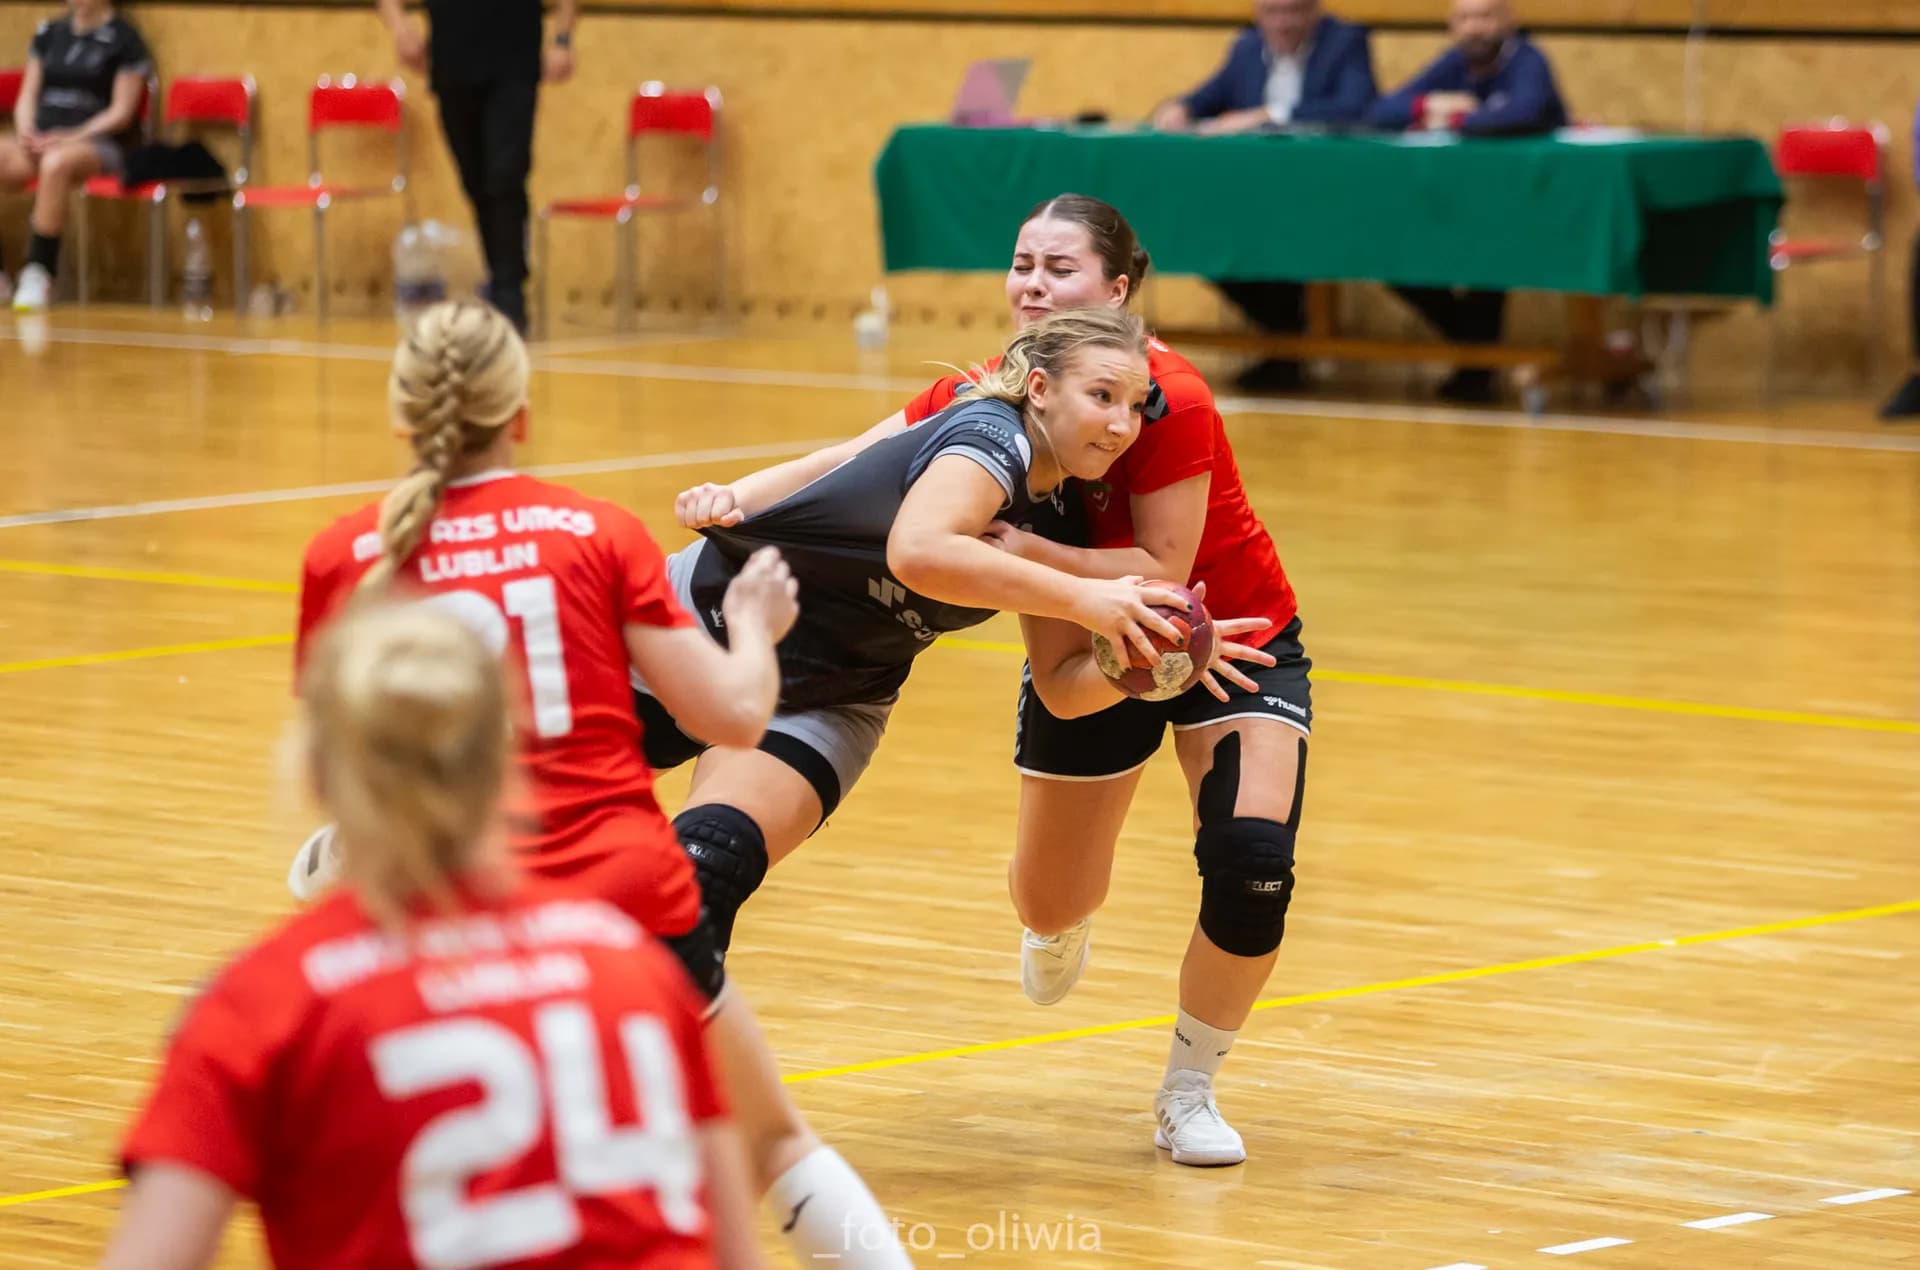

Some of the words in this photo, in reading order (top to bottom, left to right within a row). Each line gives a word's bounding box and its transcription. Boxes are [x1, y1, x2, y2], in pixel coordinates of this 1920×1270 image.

[502, 505, 596, 537] UMCS
[419, 541, 540, 583] LUBLIN
[1244, 880, 1283, 892] ELECT
[370, 1001, 707, 1269] 24
